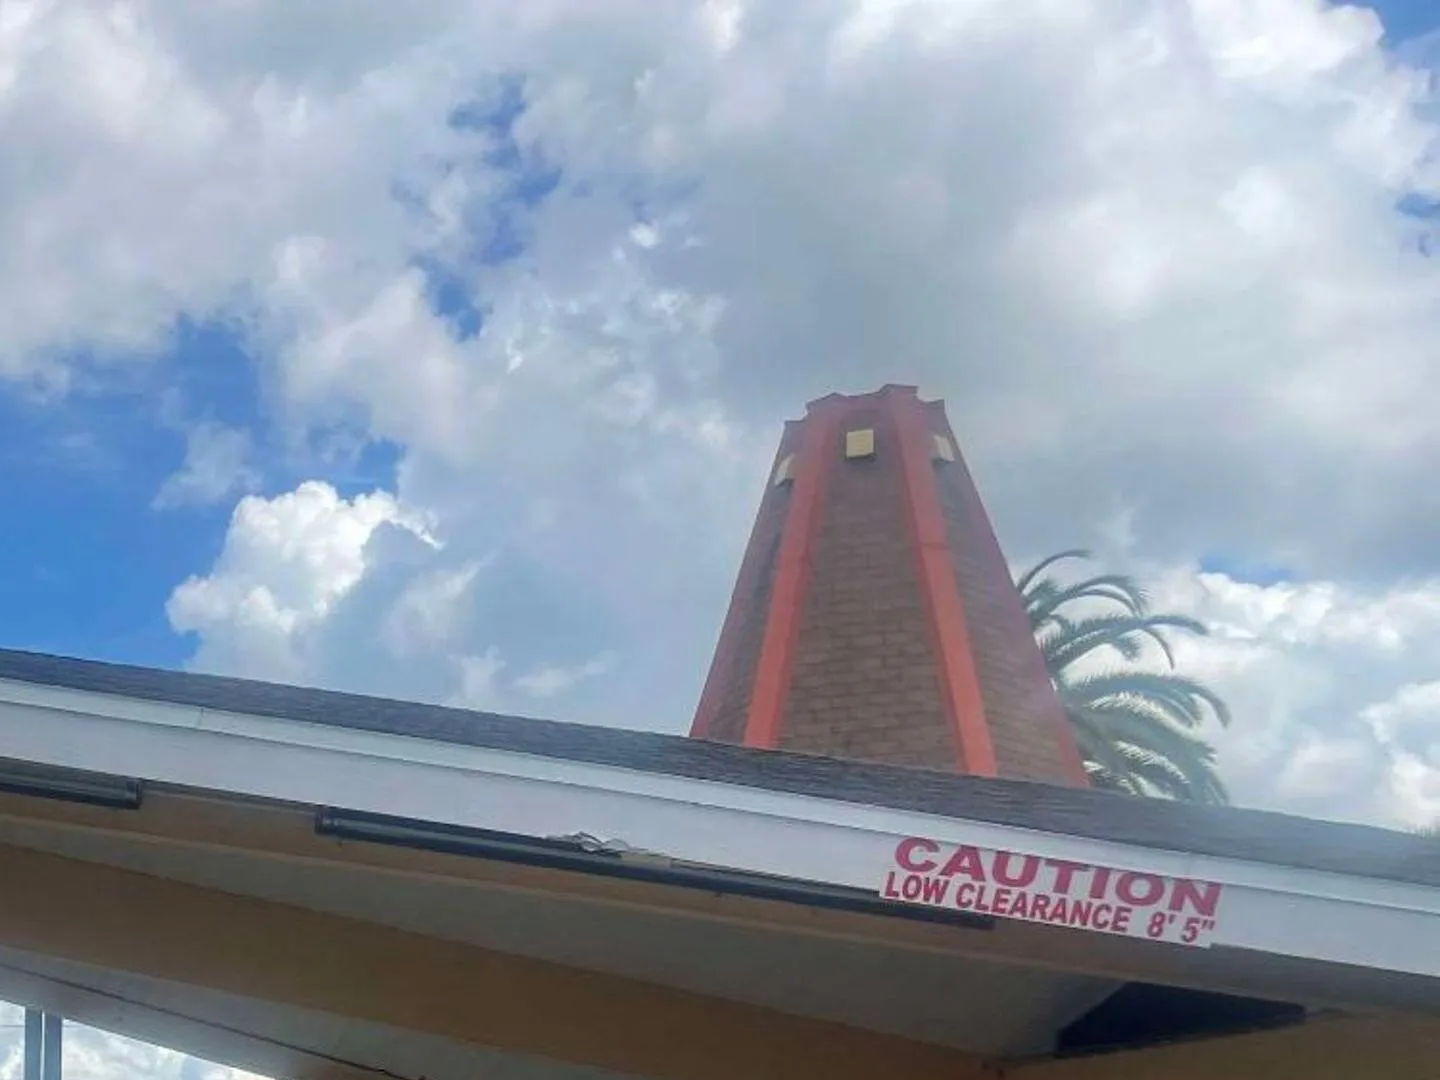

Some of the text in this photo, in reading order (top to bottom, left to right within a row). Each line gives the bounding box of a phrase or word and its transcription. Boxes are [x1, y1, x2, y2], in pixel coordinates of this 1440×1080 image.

[884, 872, 950, 905] LOW
[956, 882, 1132, 933] CLEARANCE
[1146, 910, 1175, 937] 8'
[895, 837, 1224, 917] CAUTION
